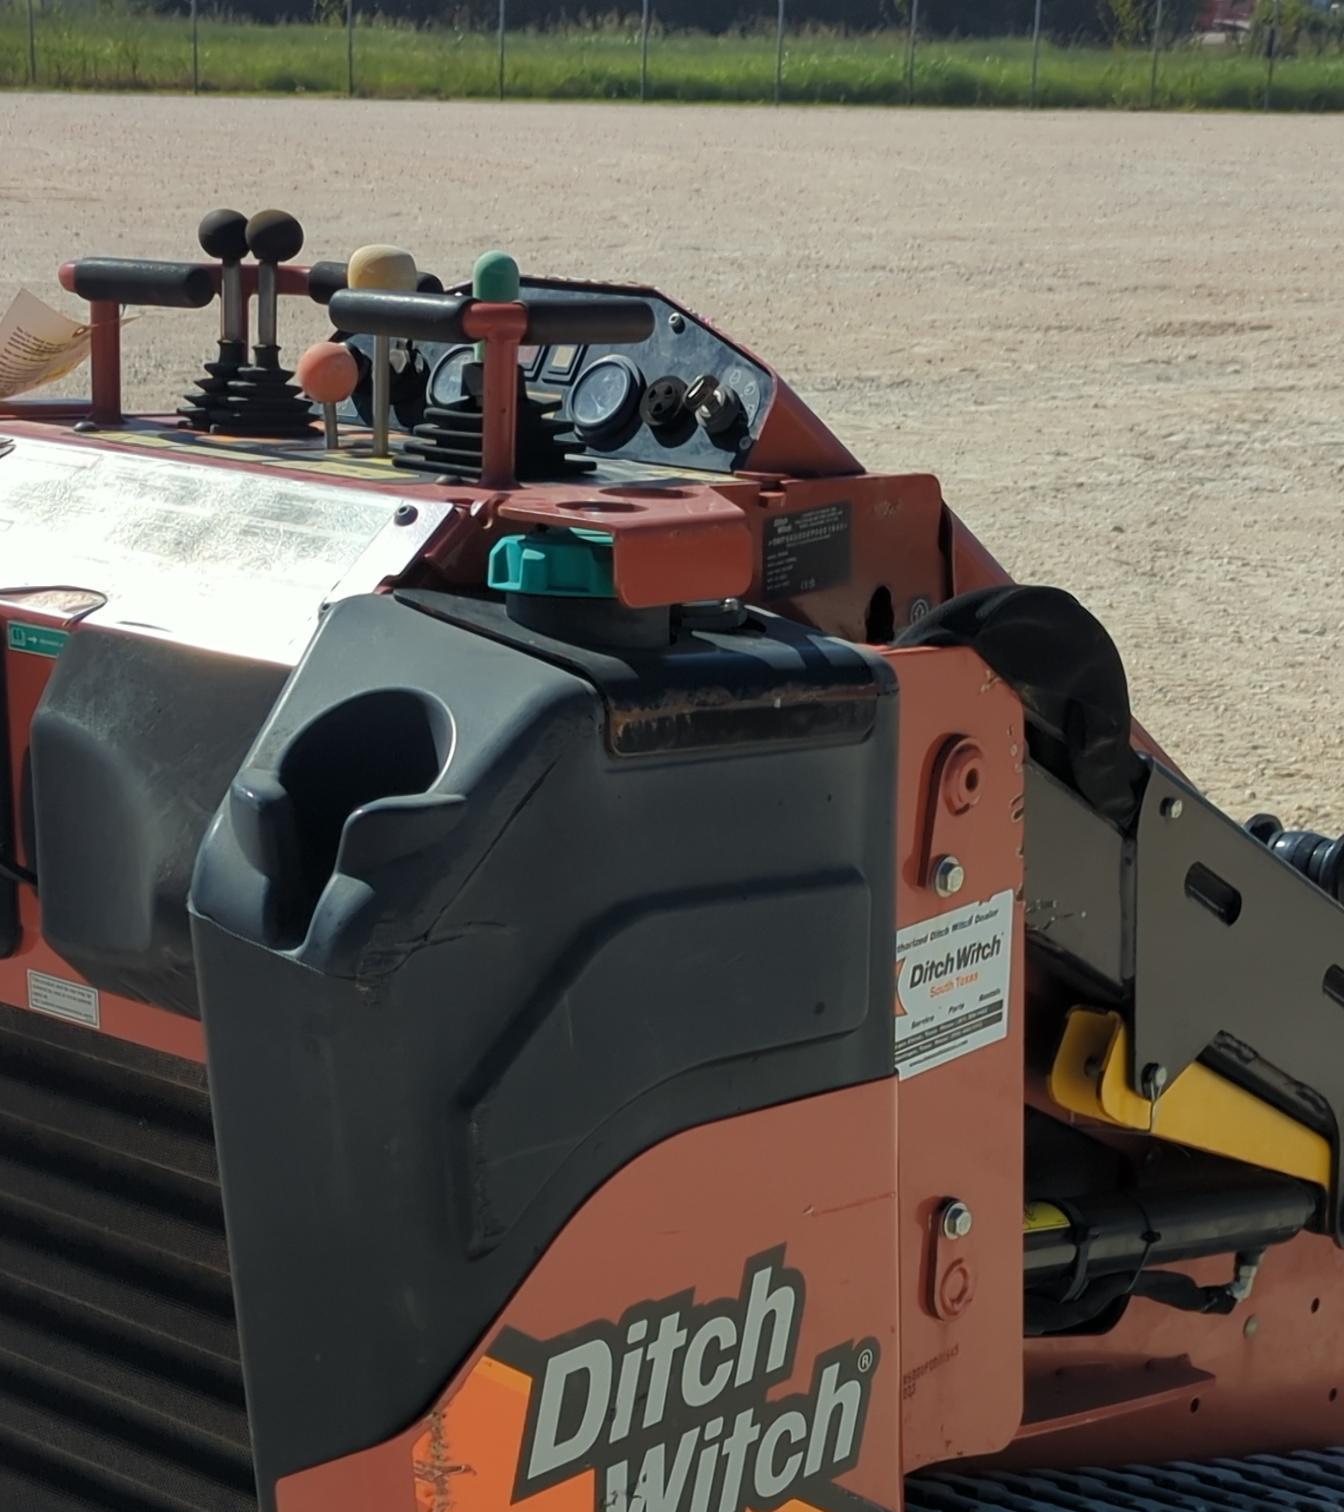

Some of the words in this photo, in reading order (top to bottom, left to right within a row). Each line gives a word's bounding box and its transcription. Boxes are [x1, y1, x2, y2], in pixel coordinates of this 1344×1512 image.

[910, 953, 955, 989] Ditch
[930, 981, 954, 998] South
[527, 1266, 795, 1480] Ditch
